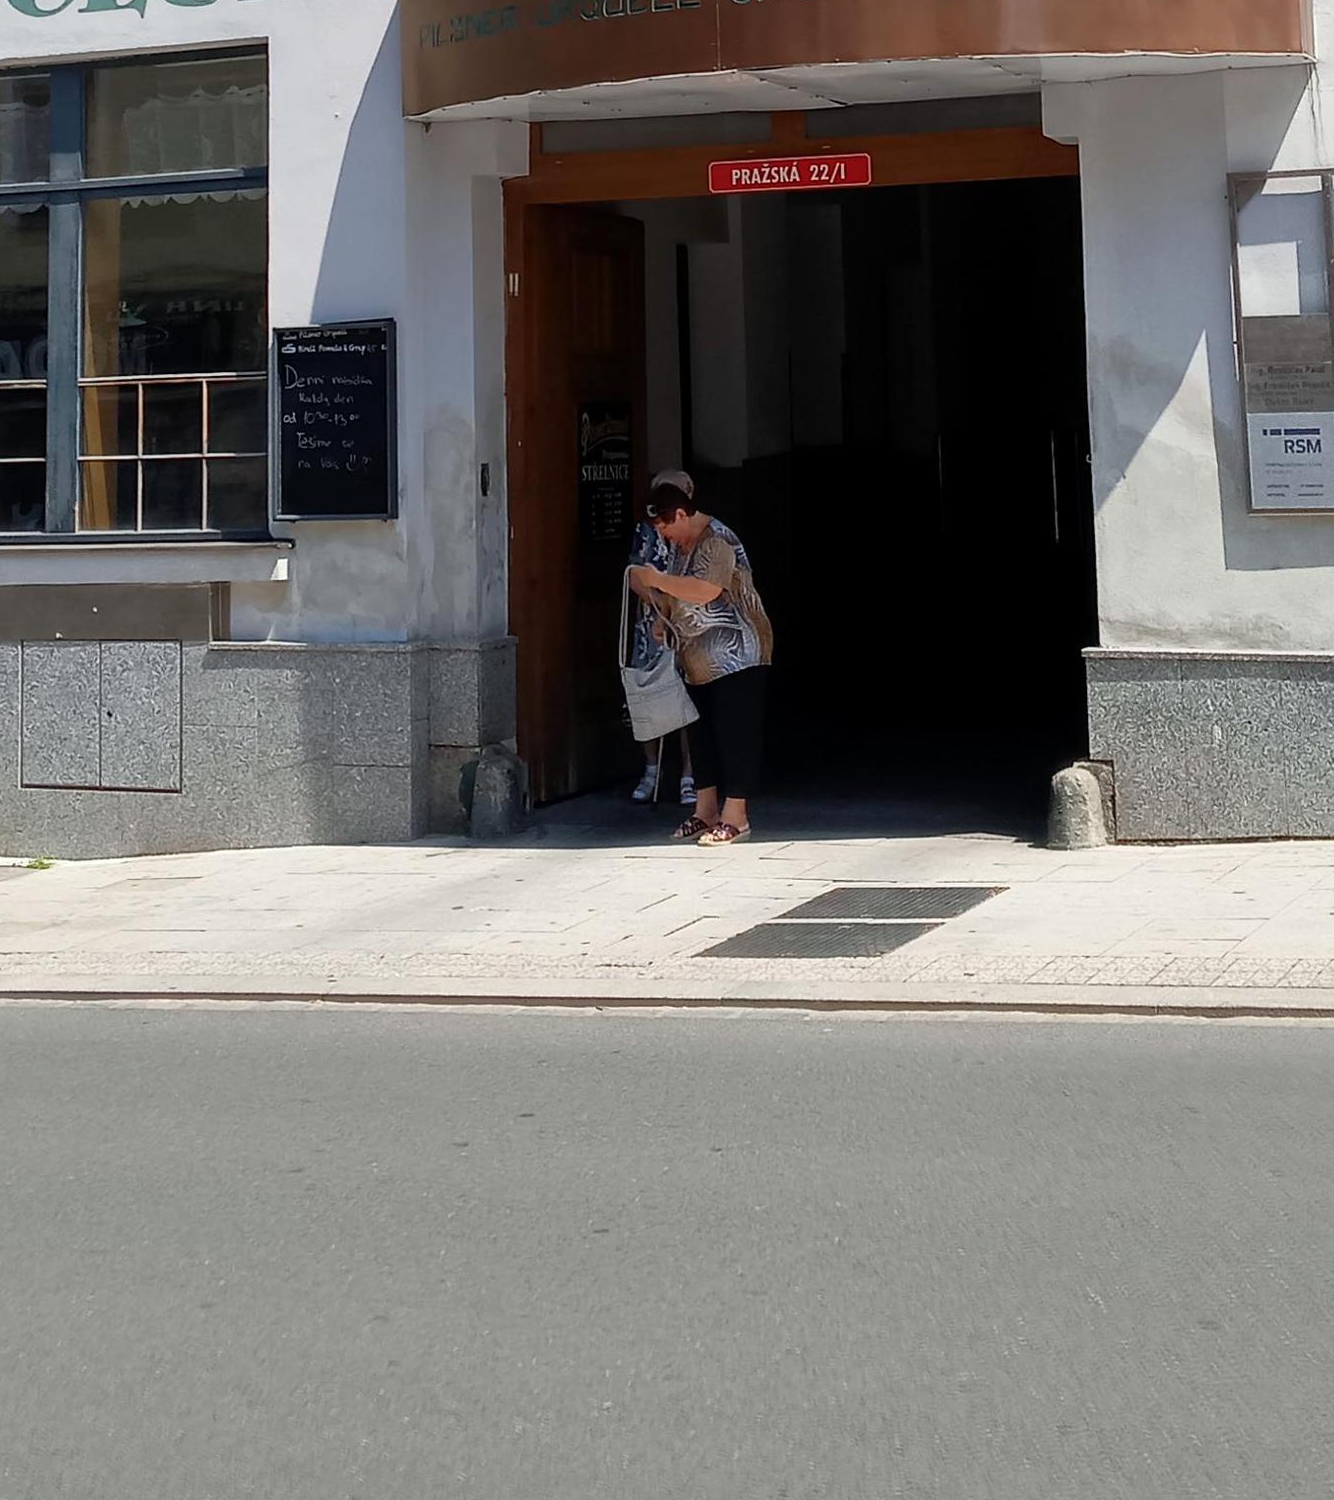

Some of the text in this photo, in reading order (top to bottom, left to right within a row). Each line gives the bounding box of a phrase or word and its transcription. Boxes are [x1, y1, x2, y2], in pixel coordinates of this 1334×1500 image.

[418, 4, 518, 51] PILSNER
[731, 161, 801, 186] PRAŽSKÁ
[1283, 438, 1322, 454] RSM
